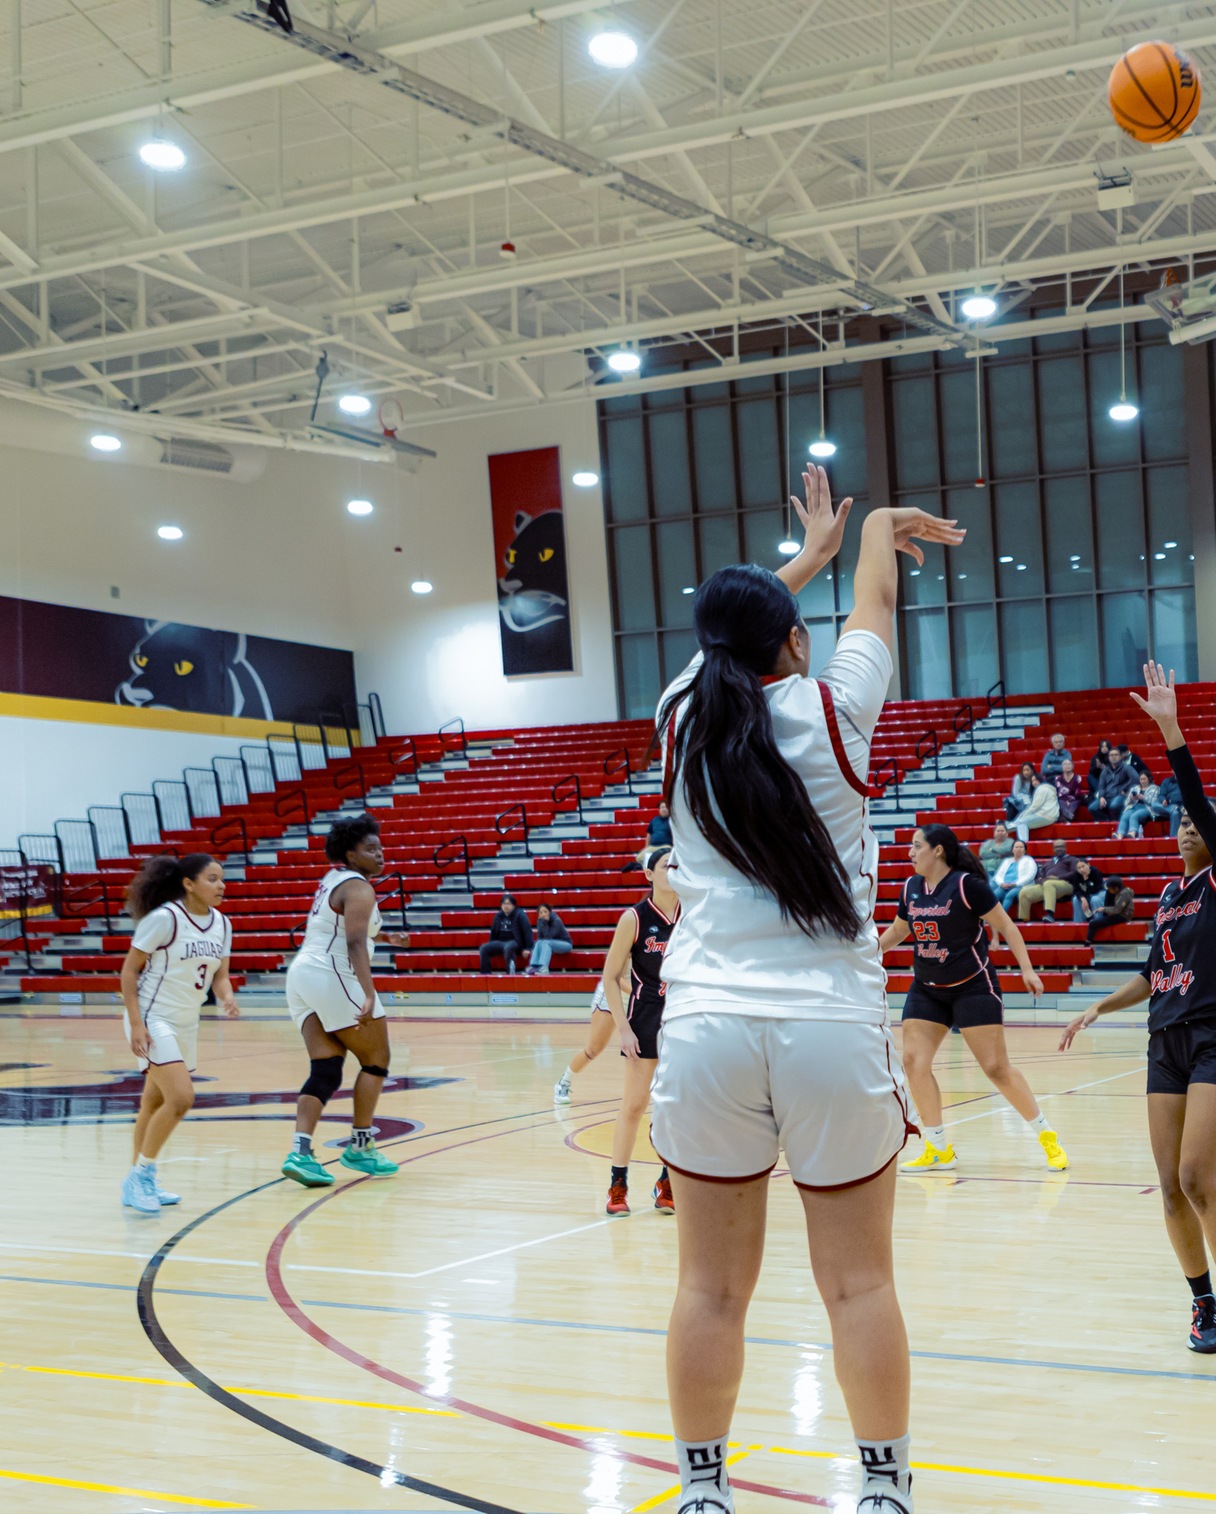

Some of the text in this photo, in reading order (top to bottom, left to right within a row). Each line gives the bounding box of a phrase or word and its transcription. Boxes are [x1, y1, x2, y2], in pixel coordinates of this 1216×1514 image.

[912, 921, 941, 941] 23
[180, 941, 223, 961] JAGUAR
[1162, 929, 1175, 963] 1
[194, 964, 208, 990] 3
